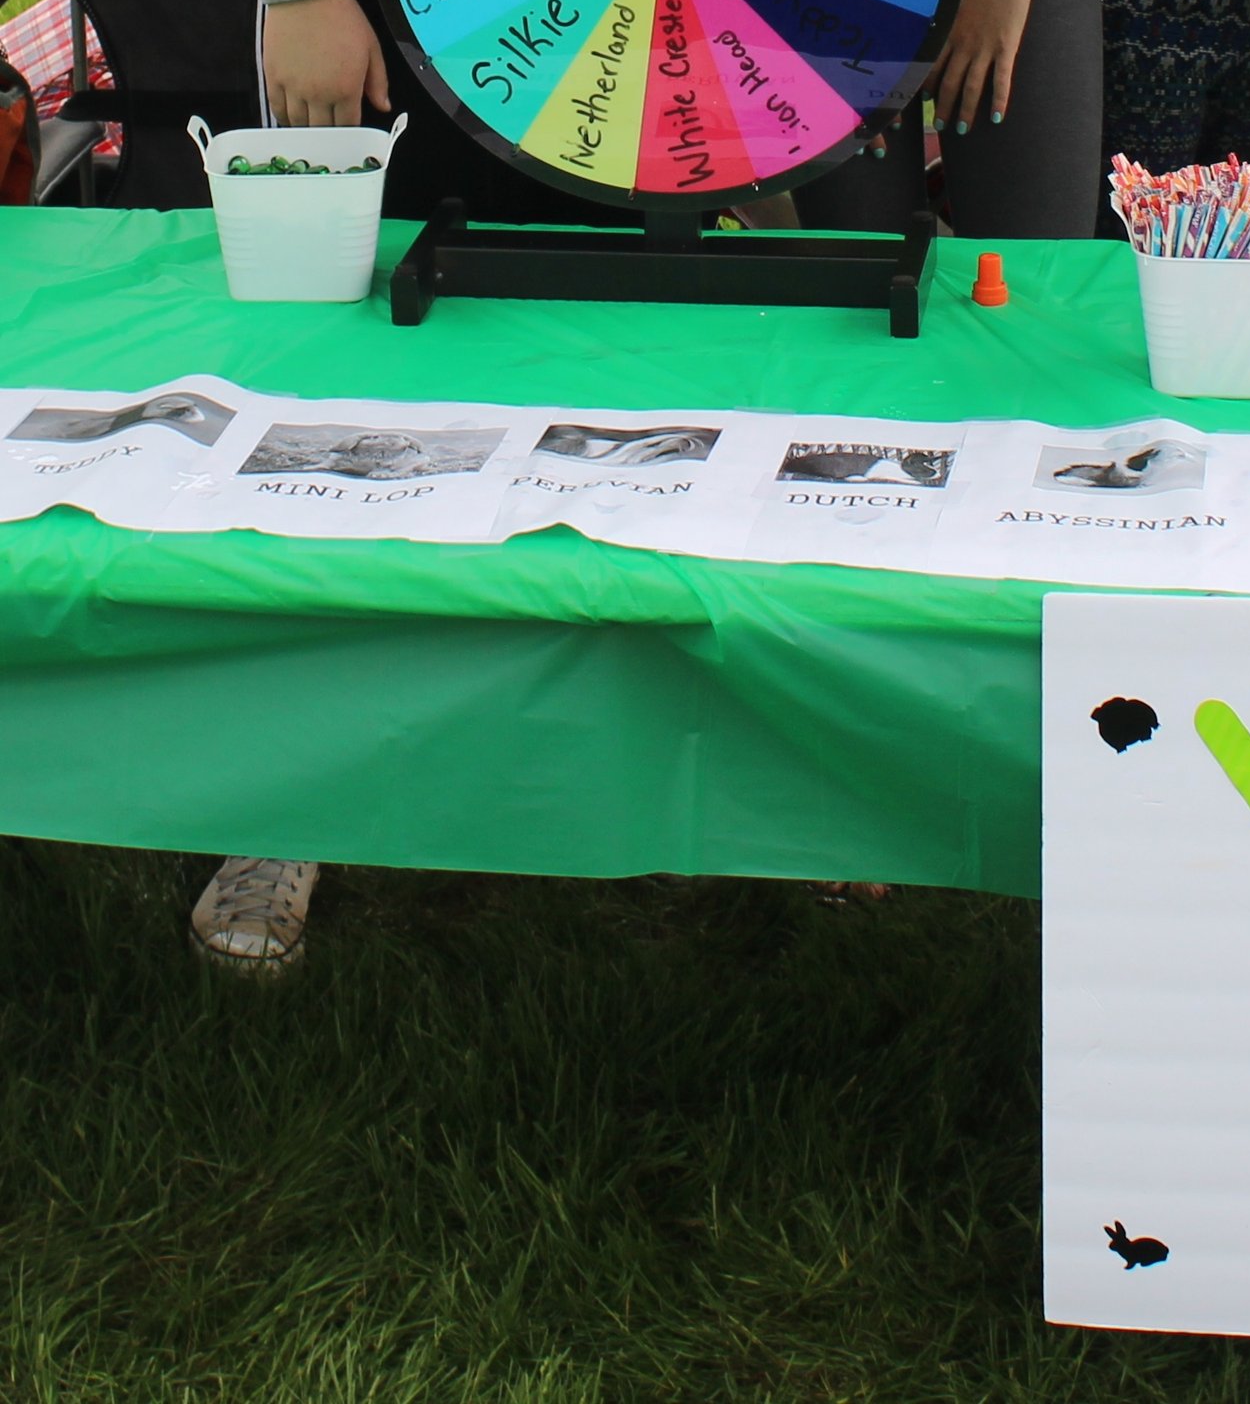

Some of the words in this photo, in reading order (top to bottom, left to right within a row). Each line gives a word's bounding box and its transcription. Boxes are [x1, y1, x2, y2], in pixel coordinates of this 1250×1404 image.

[713, 30, 769, 95] Head
[560, 3, 635, 169] Netherland
[664, 90, 715, 188] White
[35, 446, 142, 474] TEDDY
[254, 482, 349, 500] MINI
[360, 486, 435, 503] LOP
[510, 476, 695, 495] PERUVIAN
[785, 493, 919, 508] DUTCH
[995, 510, 1227, 531] ABYSSINIAN
